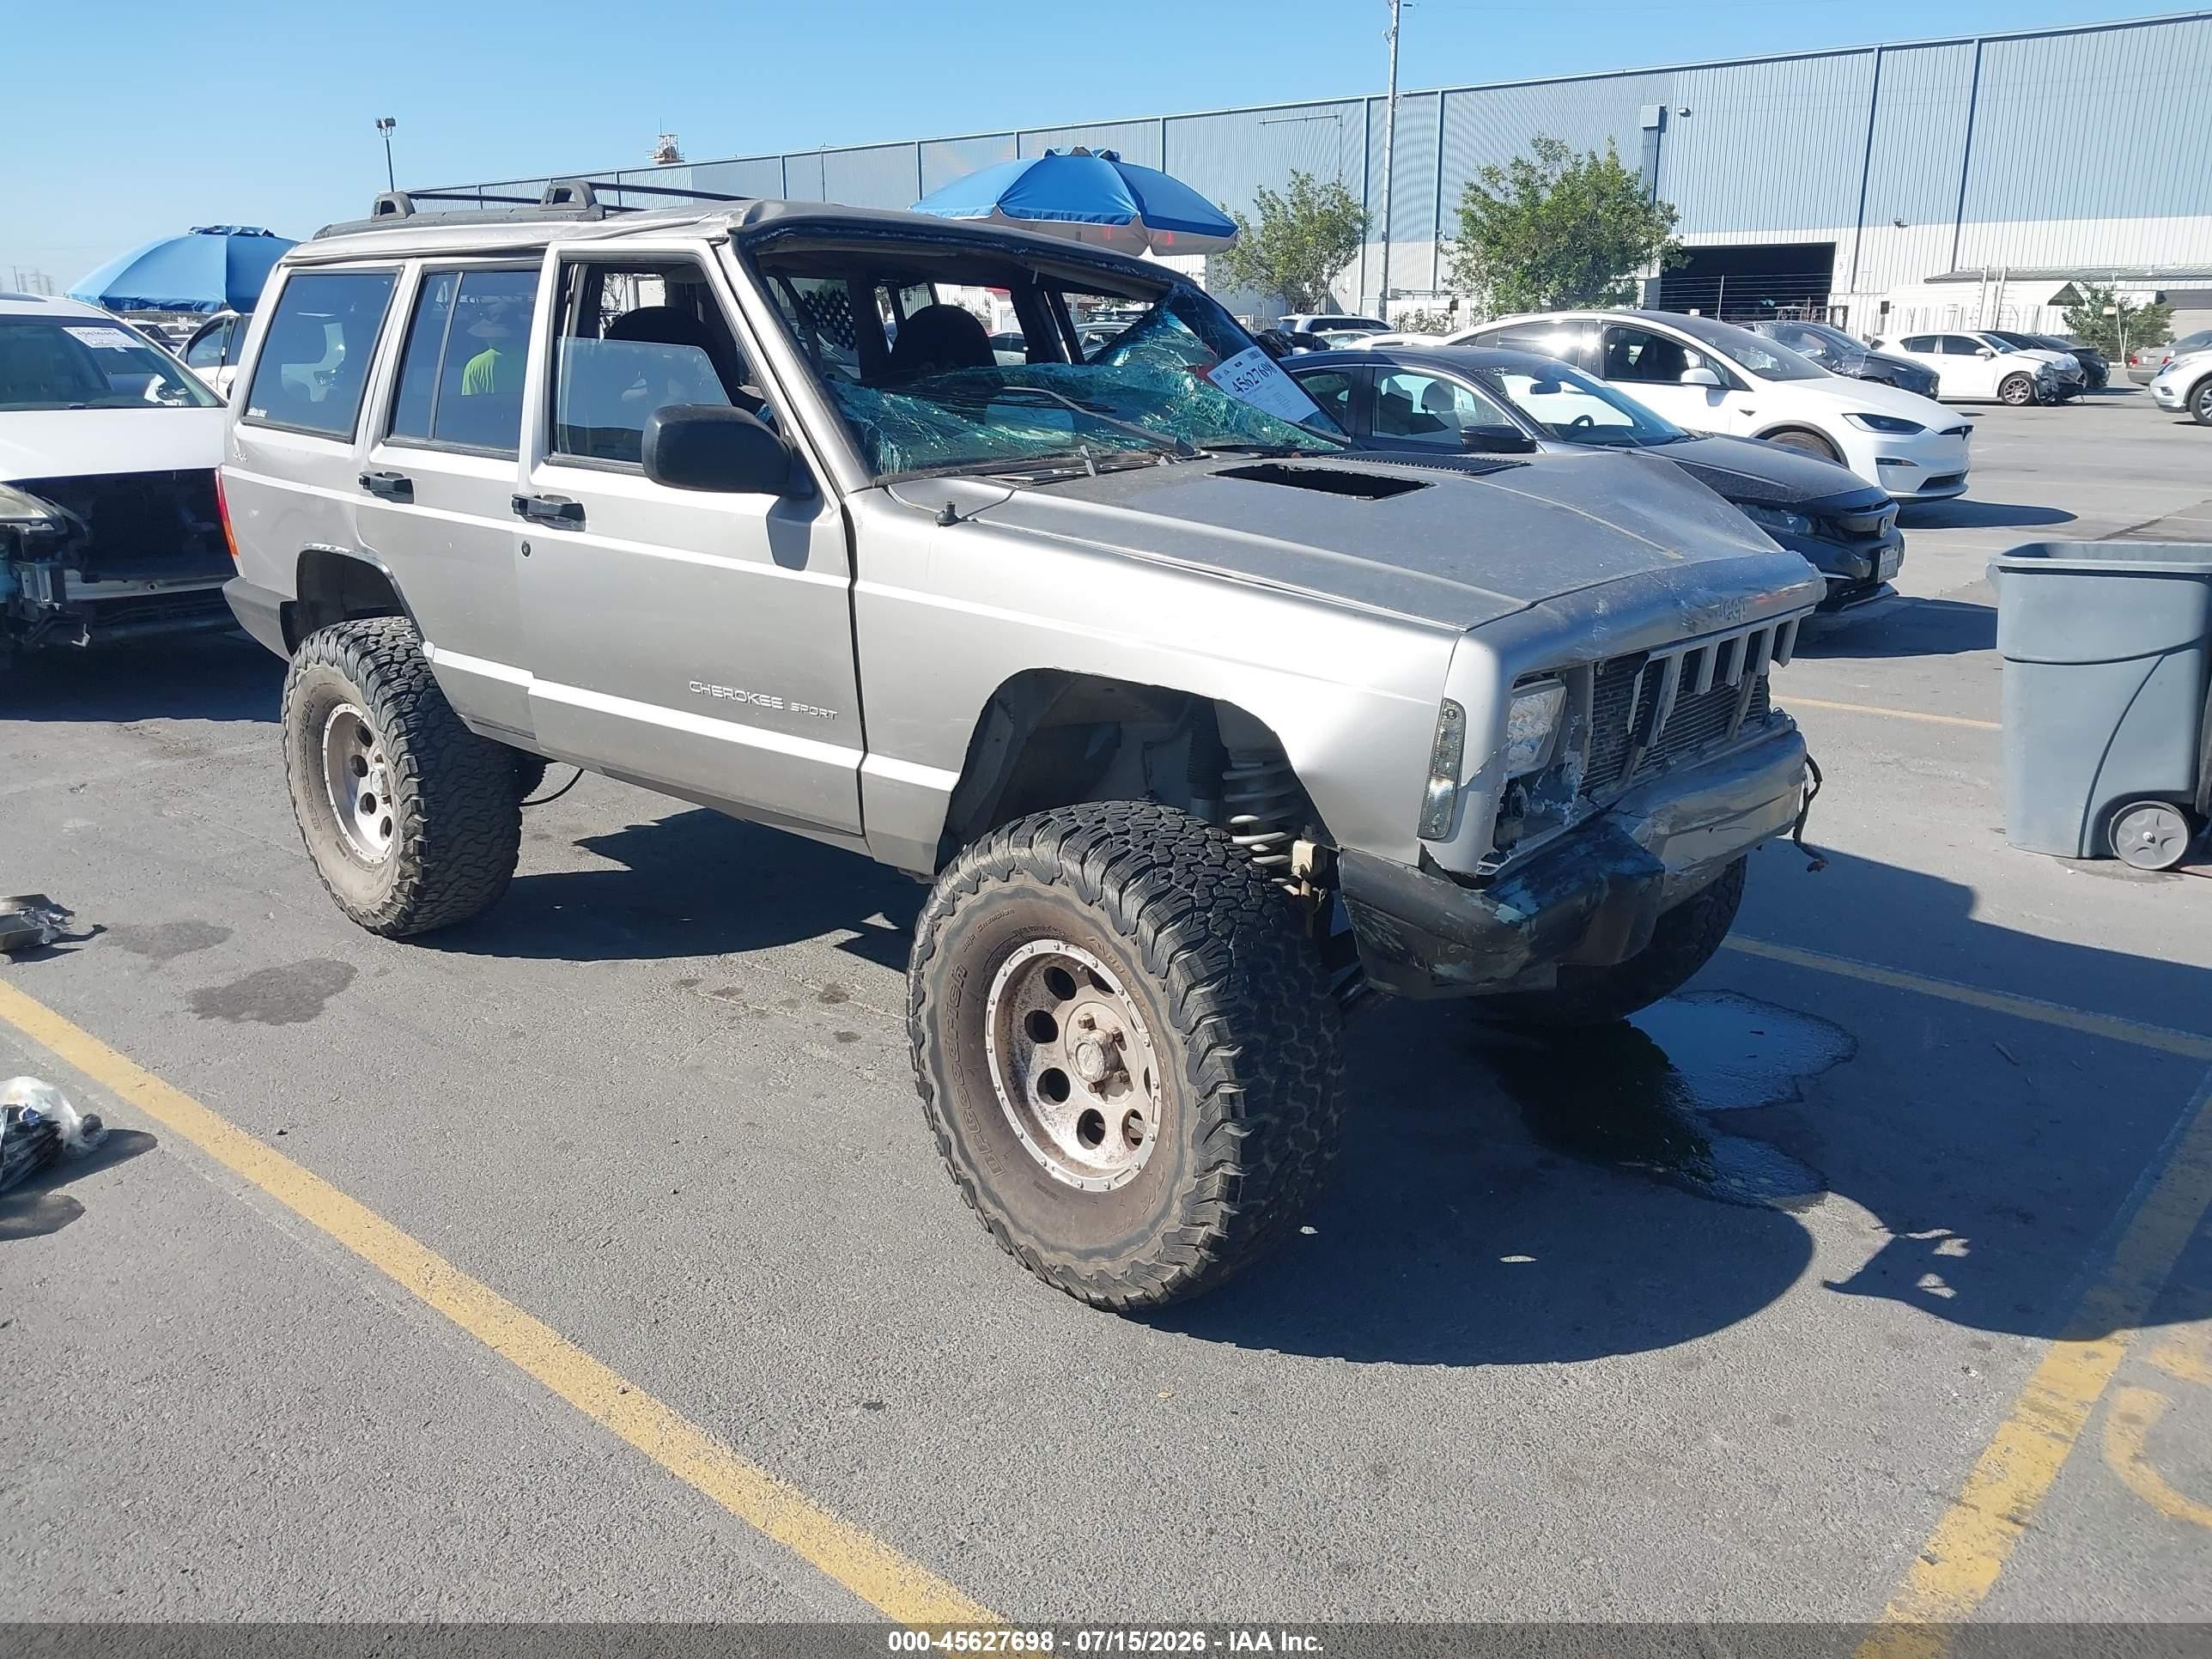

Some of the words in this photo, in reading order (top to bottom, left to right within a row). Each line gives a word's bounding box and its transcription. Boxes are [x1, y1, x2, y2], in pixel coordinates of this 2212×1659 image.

[1231, 362, 1278, 393] 45627698
[689, 679, 785, 711] CHEROKEE
[790, 702, 839, 721] SPORT
[944, 963, 1006, 1178] BFGoodrich
